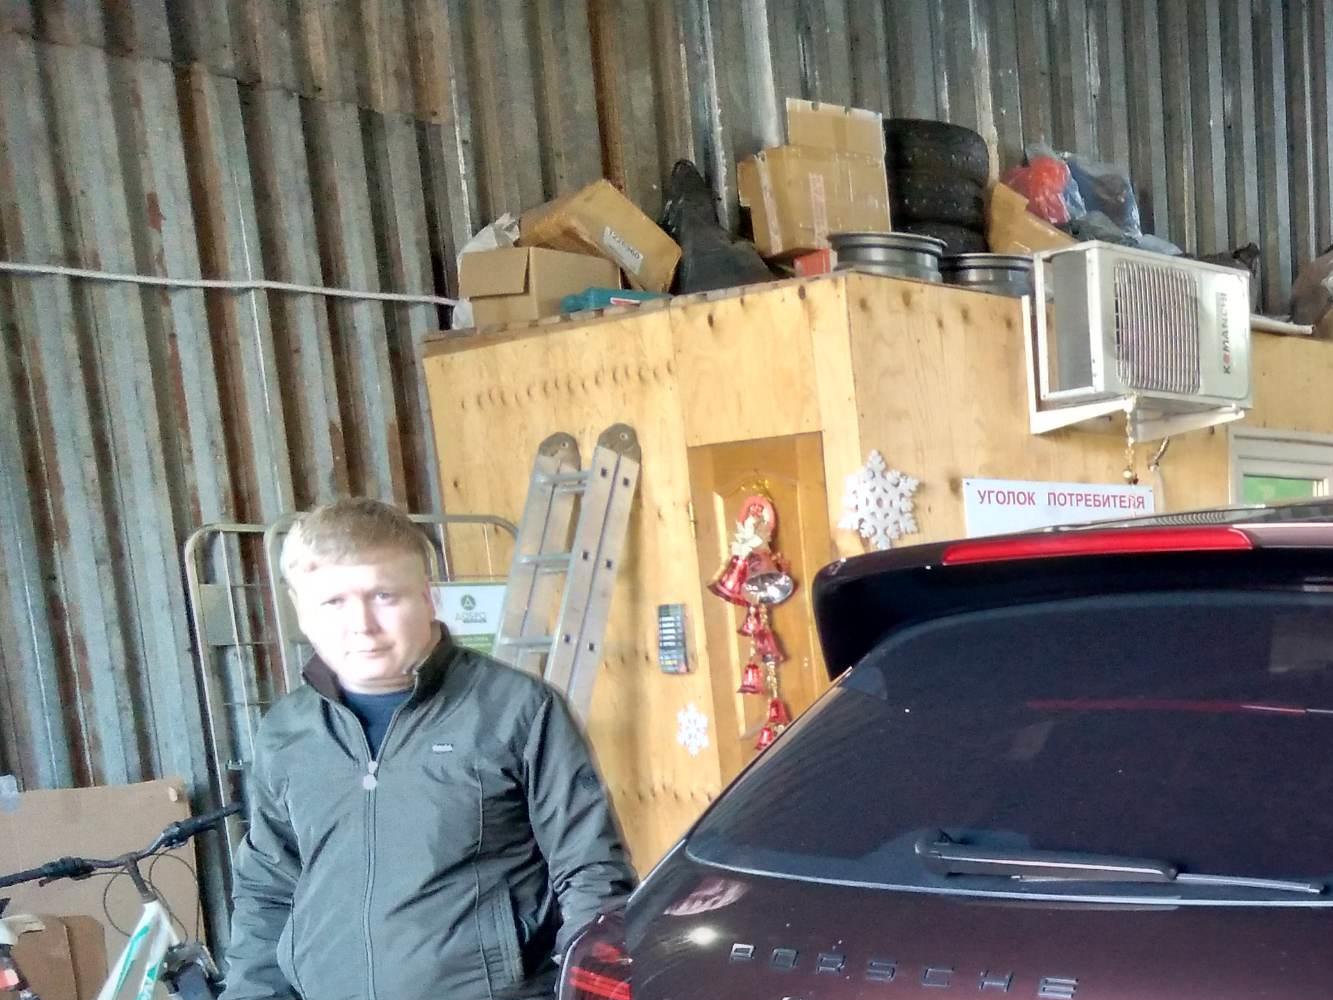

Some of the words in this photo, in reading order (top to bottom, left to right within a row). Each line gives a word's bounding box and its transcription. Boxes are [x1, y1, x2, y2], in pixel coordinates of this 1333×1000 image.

[977, 489, 1036, 506] УГОЛОК
[1047, 492, 1146, 509] ПОТРЕБИТЕЛЯ
[729, 942, 1080, 999] PORSCHE
